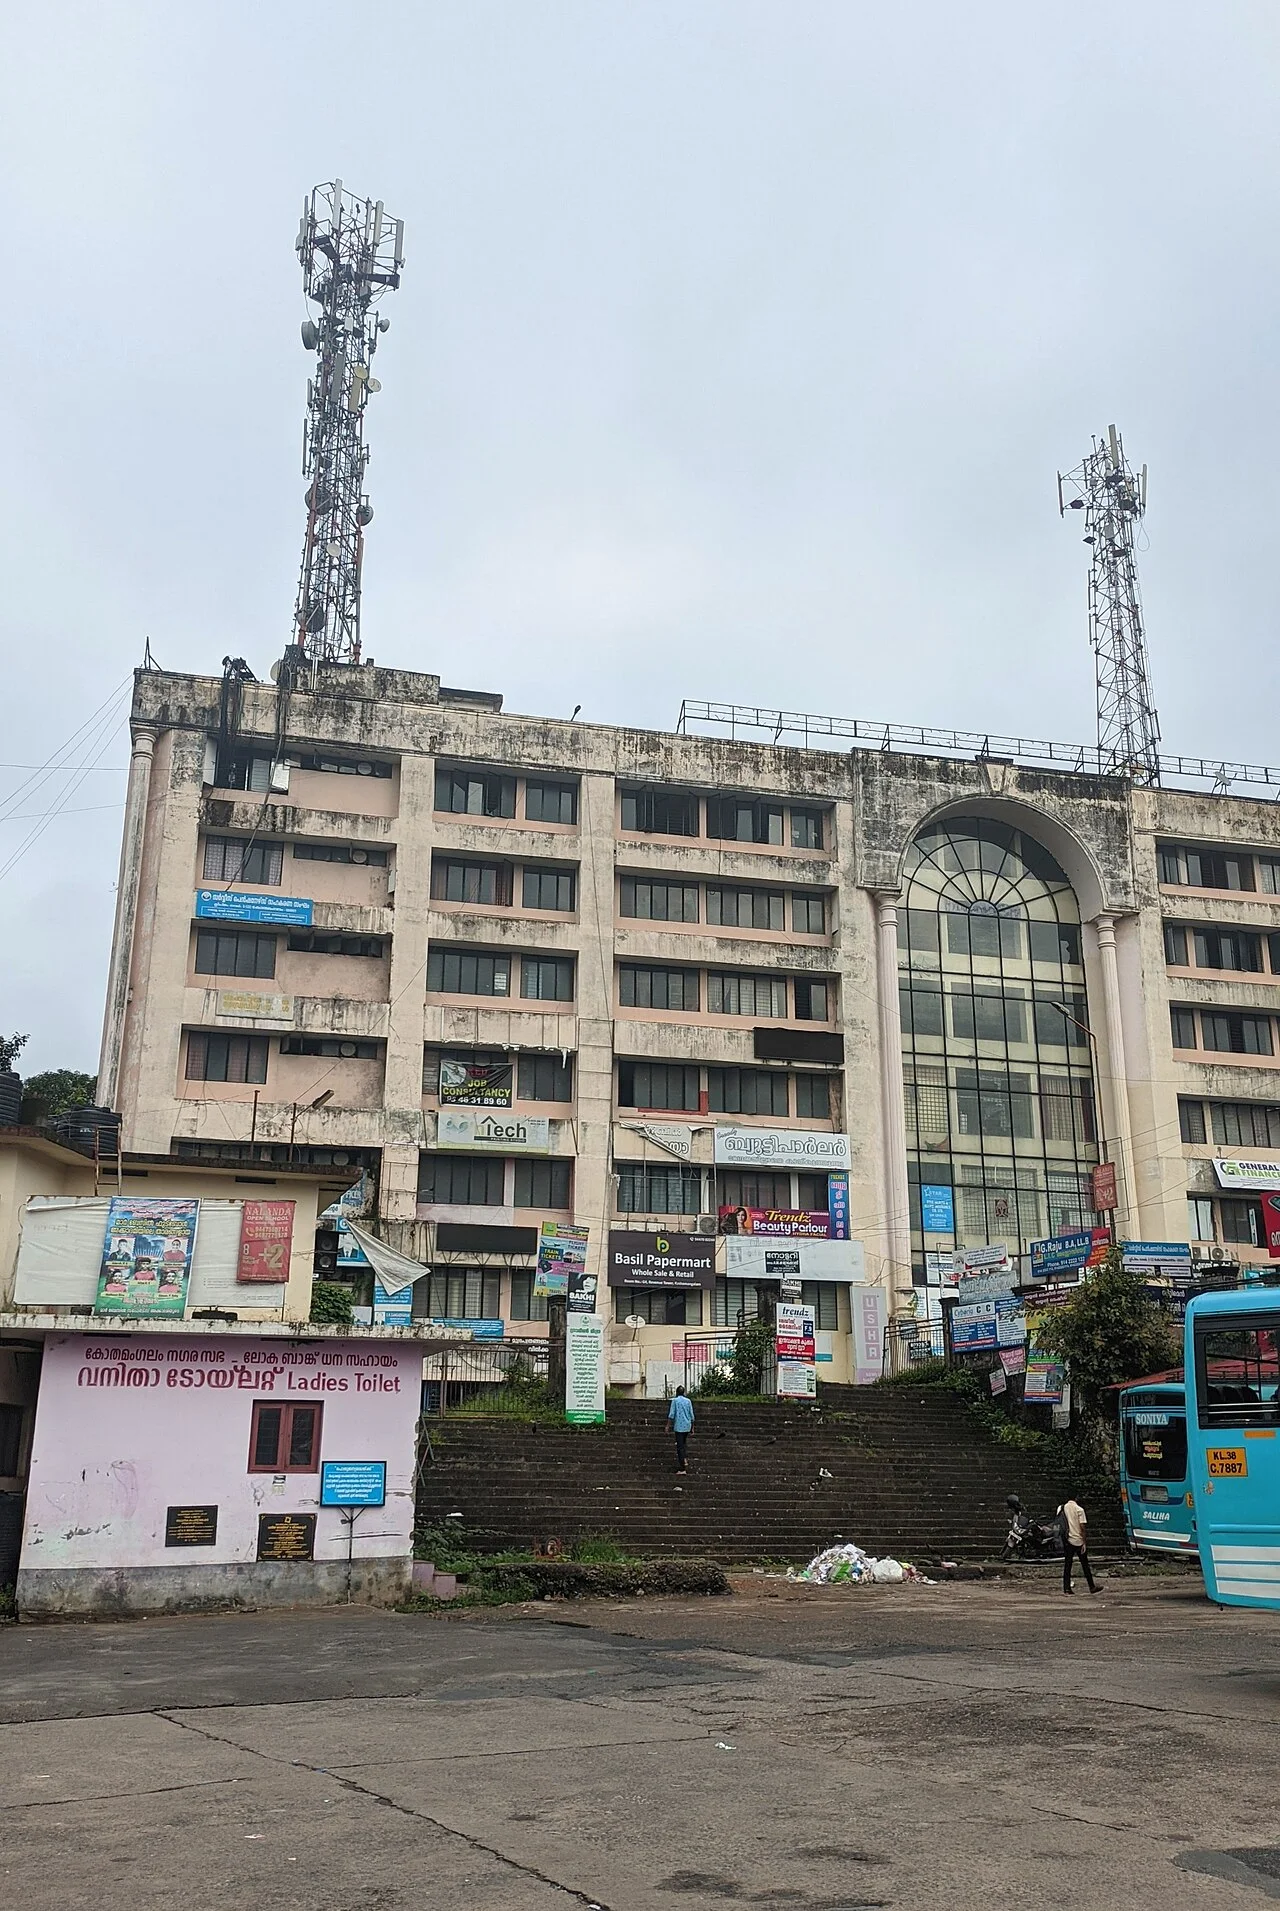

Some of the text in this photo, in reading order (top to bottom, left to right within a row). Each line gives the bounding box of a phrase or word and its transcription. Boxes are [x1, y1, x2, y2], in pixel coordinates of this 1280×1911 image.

[468, 1080, 488, 1088] JOB
[1239, 1162, 1279, 1170] GENERAL
[765, 1210, 812, 1222] Trendz
[753, 1220, 828, 1236] Beauty Parlour
[1040, 1242, 1062, 1254] G.Raju
[615, 1253, 711, 1268] Basil Papermart
[632, 1268, 653, 1276] Whole
[654, 1269, 668, 1277] Sale
[676, 1270, 694, 1278] Retail
[568, 1292, 594, 1301] SAKHI
[782, 1306, 809, 1316] trendz
[85, 1348, 164, 1362] കോതമംഗലം
[244, 1352, 278, 1364] ലോക
[282, 1352, 320, 1366] ബാങ്ക്
[346, 1354, 398, 1367] സഹായം
[78, 1362, 160, 1388] വനിതാ
[288, 1371, 401, 1392] Ladies Toilet
[1136, 1414, 1168, 1425] SONIYA
[1213, 1452, 1236, 1460] KL.38
[1210, 1463, 1242, 1474] C.7887
[1142, 1511, 1170, 1520] SALIHA
